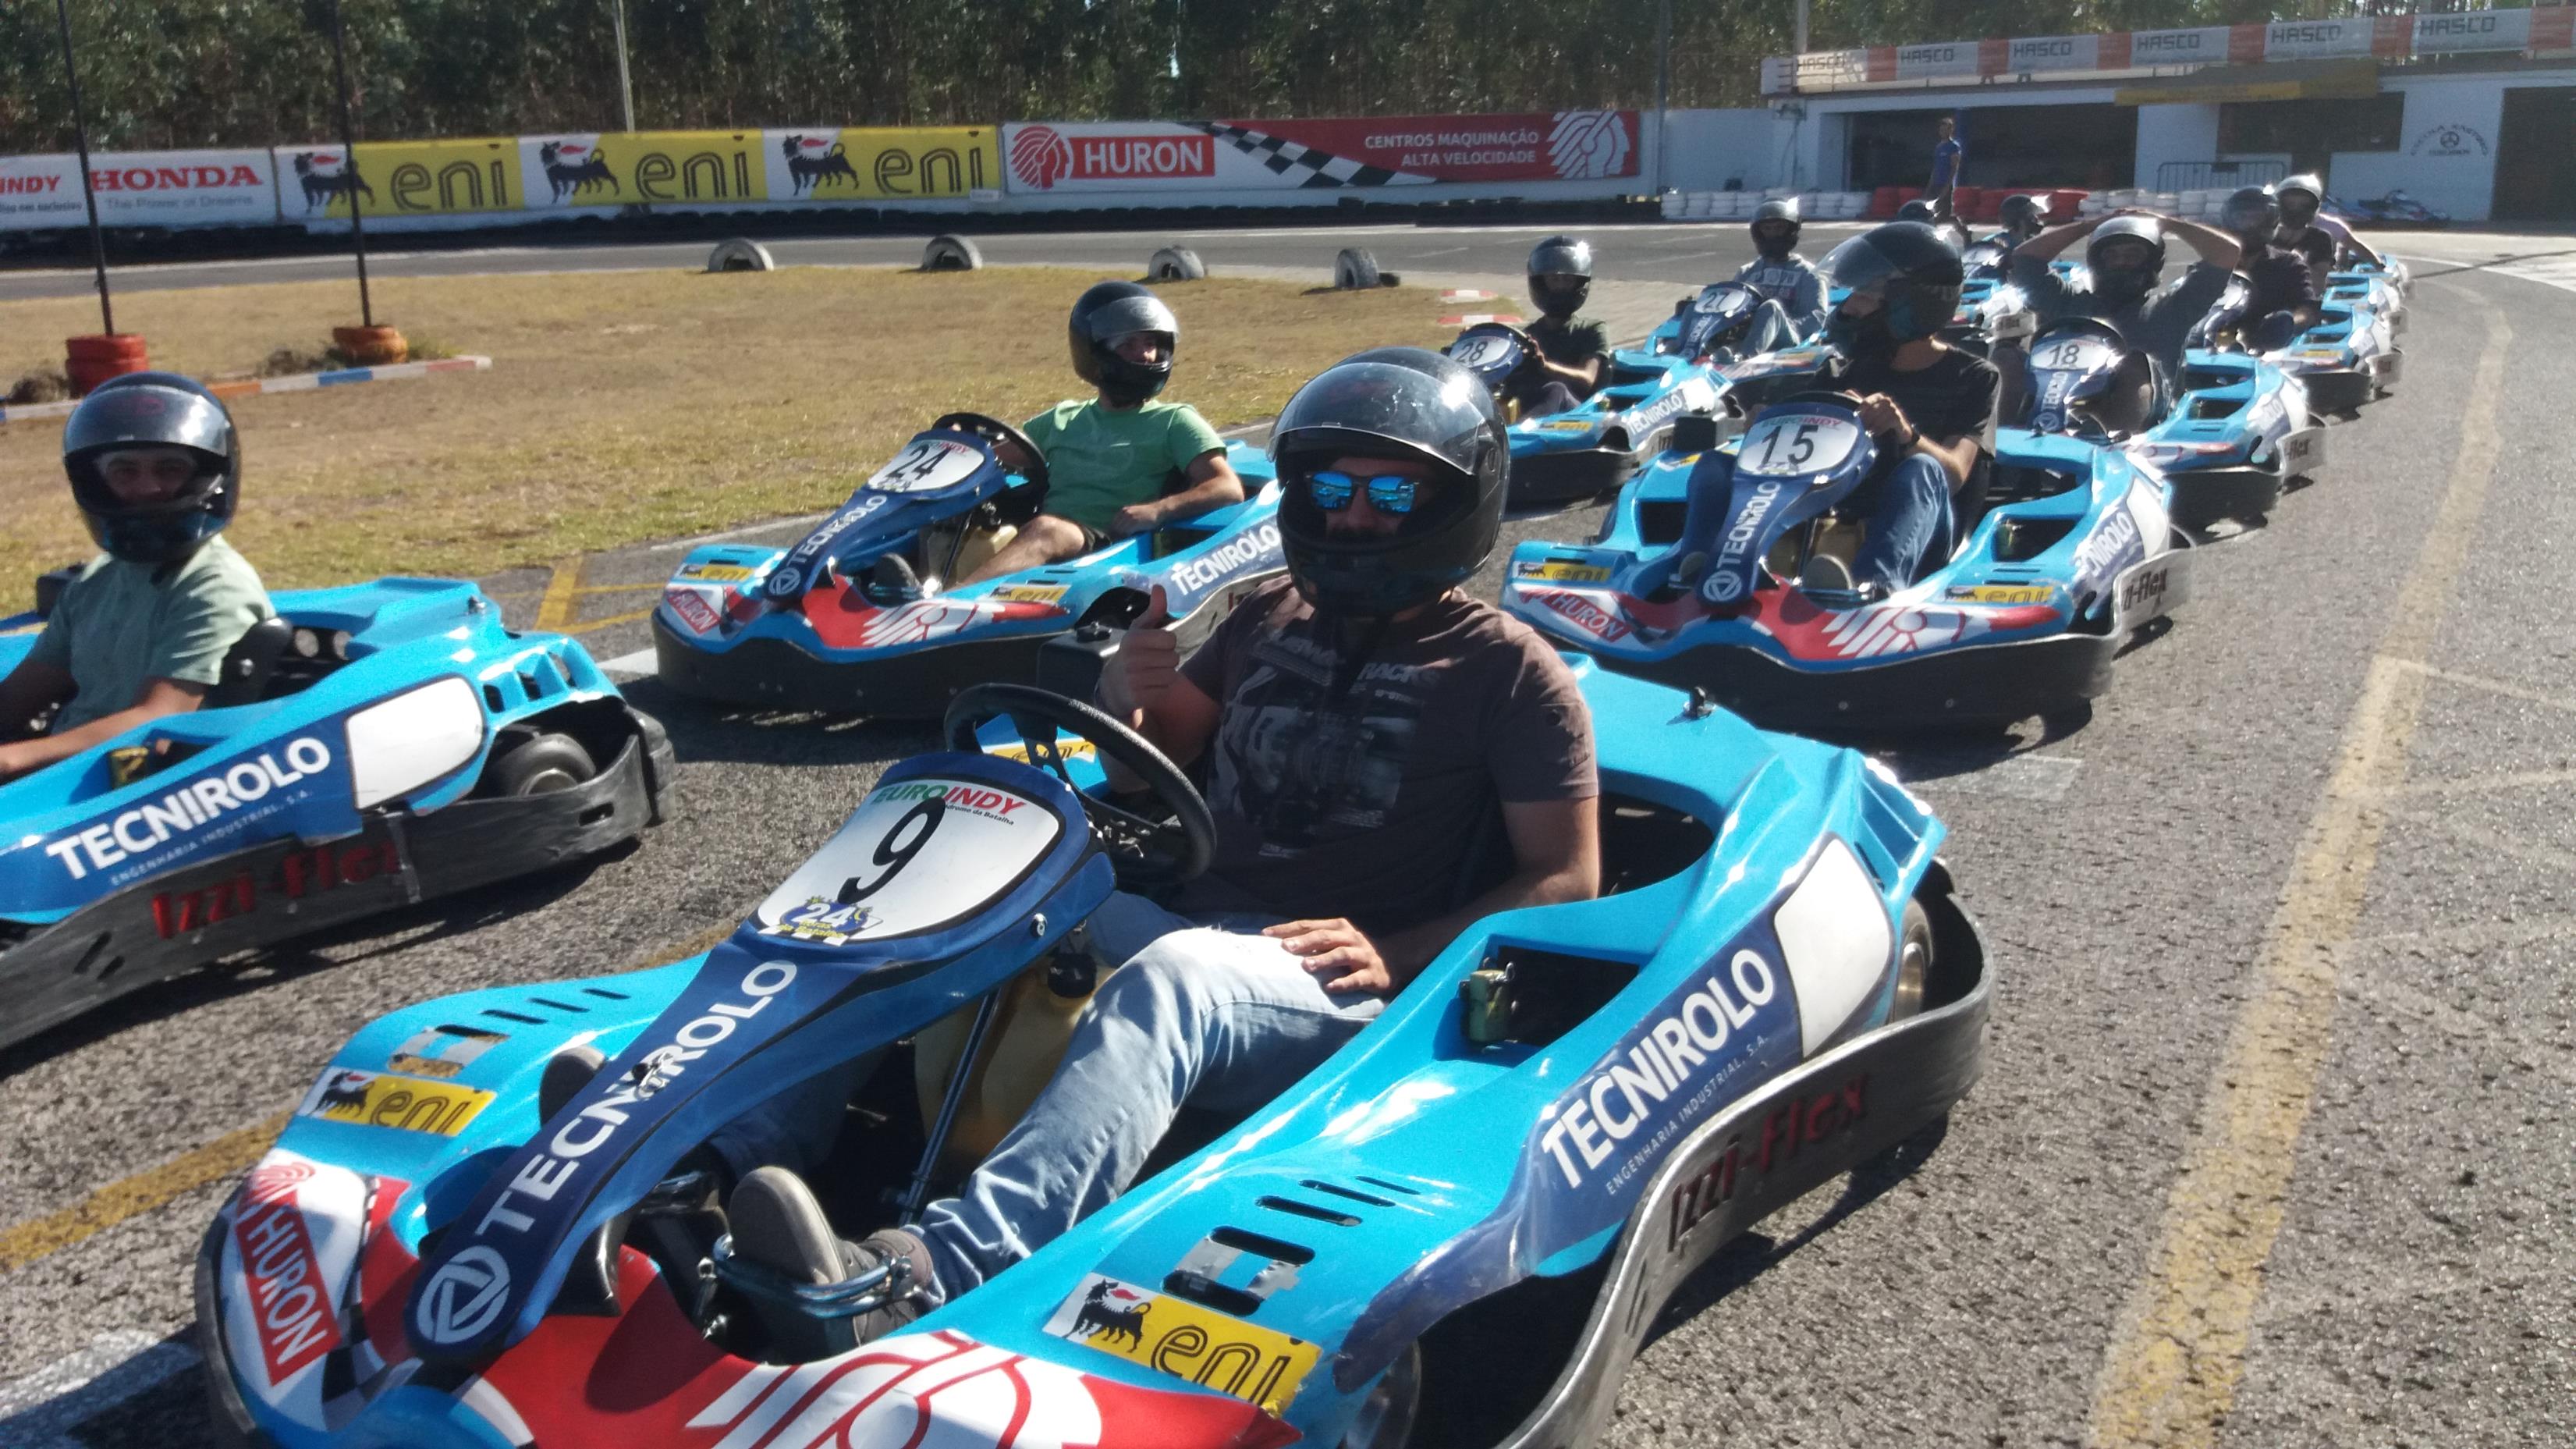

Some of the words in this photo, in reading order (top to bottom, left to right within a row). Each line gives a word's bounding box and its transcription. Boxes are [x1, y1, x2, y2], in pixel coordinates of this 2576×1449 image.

[1900, 48, 1955, 64] HASCO
[2013, 41, 2073, 58] HASCO
[2136, 34, 2202, 51] HASCO
[1084, 140, 1204, 174] HURON
[1364, 133, 1435, 149] CENTROS
[1438, 128, 1539, 148] MAQUINAÇÃO
[391, 143, 509, 211] eni
[634, 134, 750, 200] eni
[873, 130, 985, 195] eni
[1400, 153, 1441, 167] ALTA
[1442, 150, 1536, 165] VELOCIDADE
[89, 165, 263, 192] HONDA
[1703, 292, 1730, 312] 27
[1456, 343, 1488, 363] 28
[2049, 343, 2080, 366] 18
[885, 443, 953, 481] 24
[1761, 424, 1819, 466] 15
[1171, 524, 1281, 596] TECNIROLO
[1552, 568, 1604, 581] eni
[672, 593, 718, 630] HURON
[1551, 592, 1624, 641] HURON
[46, 737, 332, 880] TECNIROLO
[871, 784, 1027, 815] EUROINDY
[972, 808, 983, 817] da
[983, 812, 1015, 826] Batalha
[110, 842, 198, 886] ENGENHARIA
[837, 797, 946, 905] 9
[790, 902, 858, 928] 24
[1540, 948, 1775, 1189] TECNIROLO
[369, 1085, 484, 1135] eni
[1605, 1120, 1679, 1196] ENGENHARIA
[247, 1209, 330, 1366] HURON
[1150, 1323, 1304, 1406] eni
